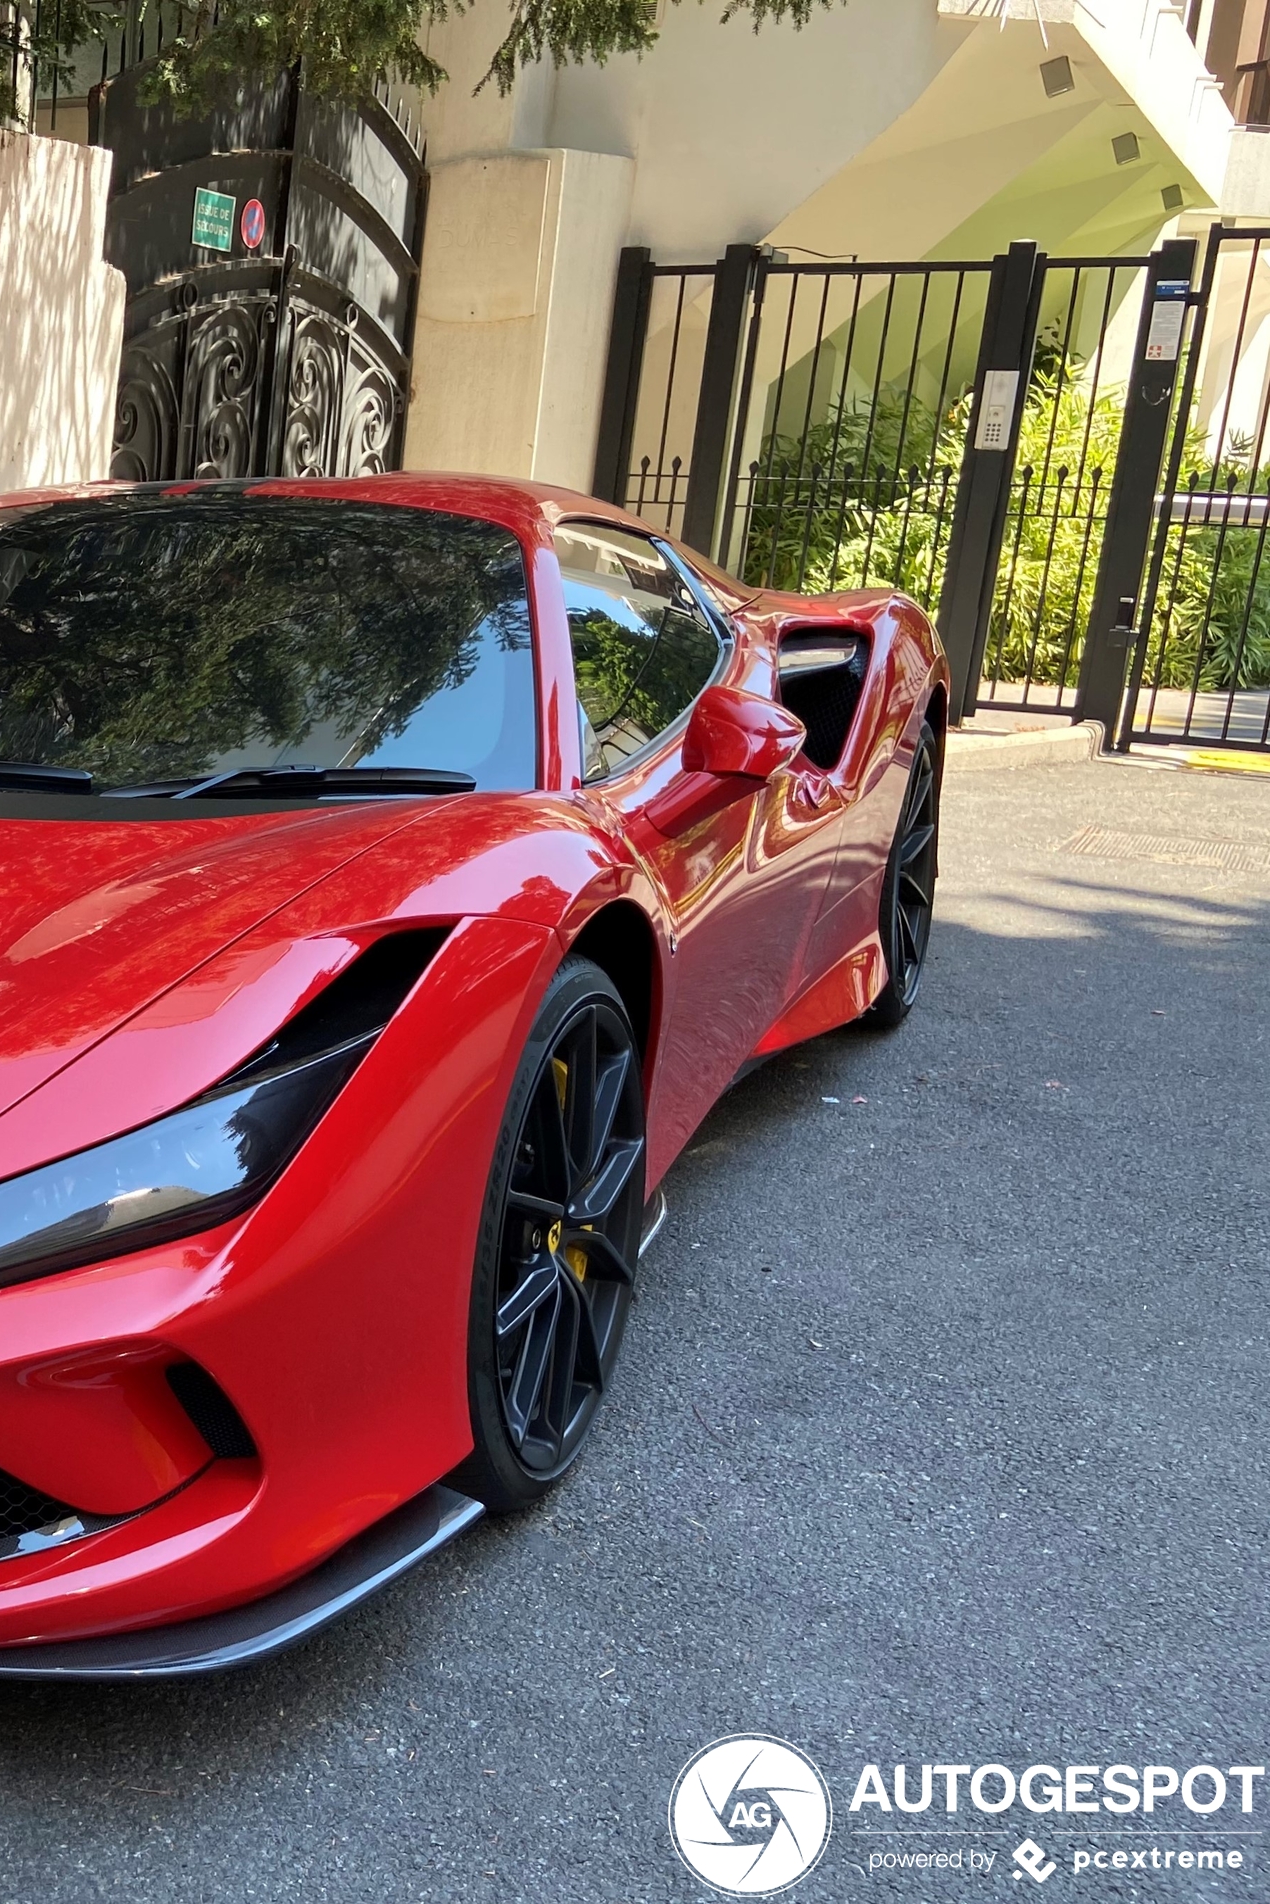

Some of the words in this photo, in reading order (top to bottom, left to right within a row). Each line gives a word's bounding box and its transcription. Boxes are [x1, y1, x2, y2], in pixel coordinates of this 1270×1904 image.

[198, 203, 219, 218] ISSUE
[220, 208, 230, 221] DE
[196, 219, 228, 237] SECOURS
